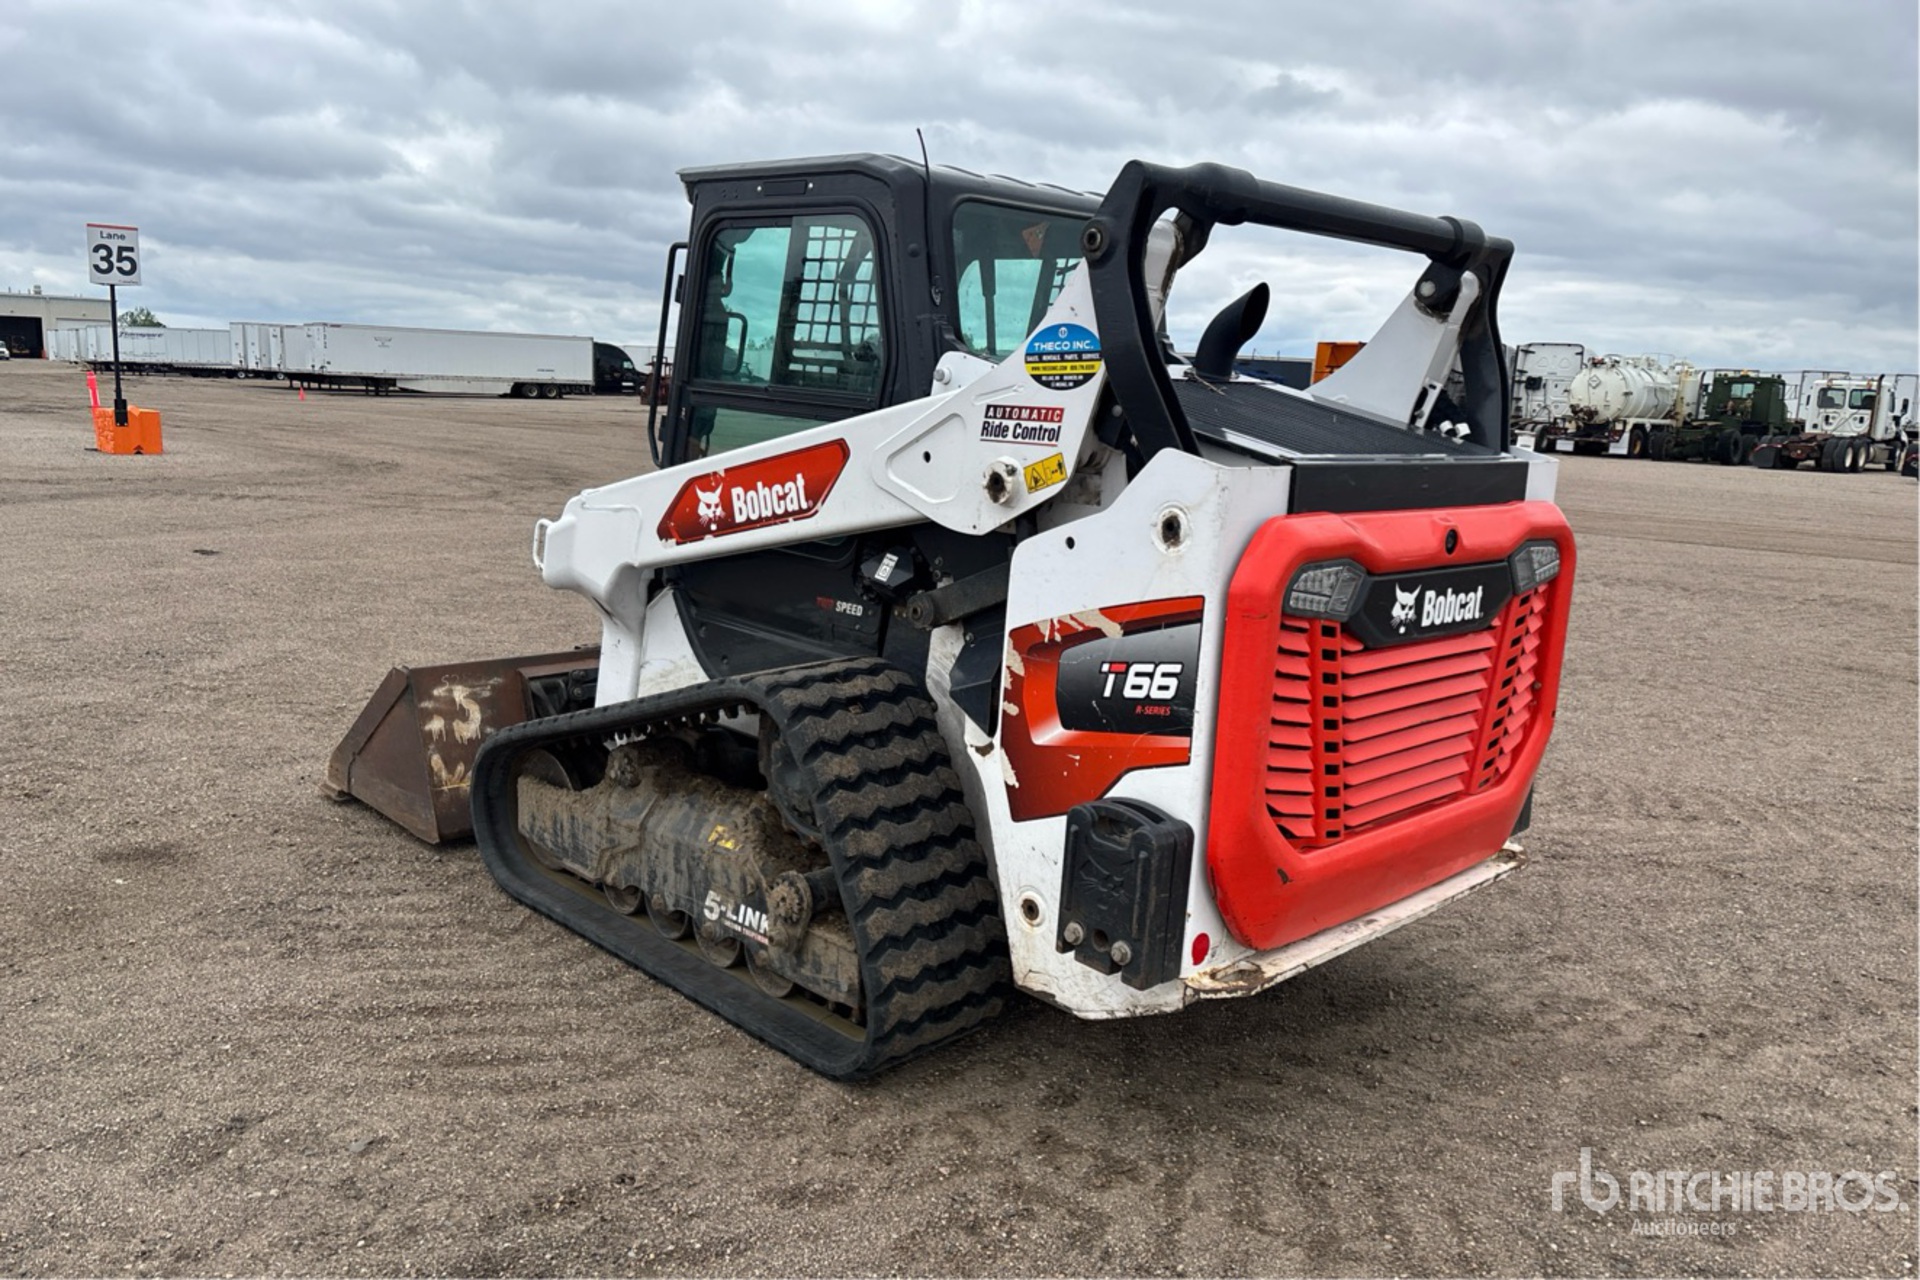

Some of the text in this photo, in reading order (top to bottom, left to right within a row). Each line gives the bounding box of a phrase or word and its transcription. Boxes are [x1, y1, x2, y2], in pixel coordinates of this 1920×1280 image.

[100, 230, 126, 240] Lane
[92, 243, 137, 276] 35
[1034, 340, 1094, 351] THECO INC.
[987, 406, 1062, 422] AUTOMATIC
[980, 421, 1061, 442] Ride Control
[731, 473, 808, 524] Bobcat
[835, 600, 863, 617] SPEED
[1421, 585, 1483, 628] Bobcat
[1101, 662, 1183, 699] T66
[1135, 704, 1171, 716] R-SERIES
